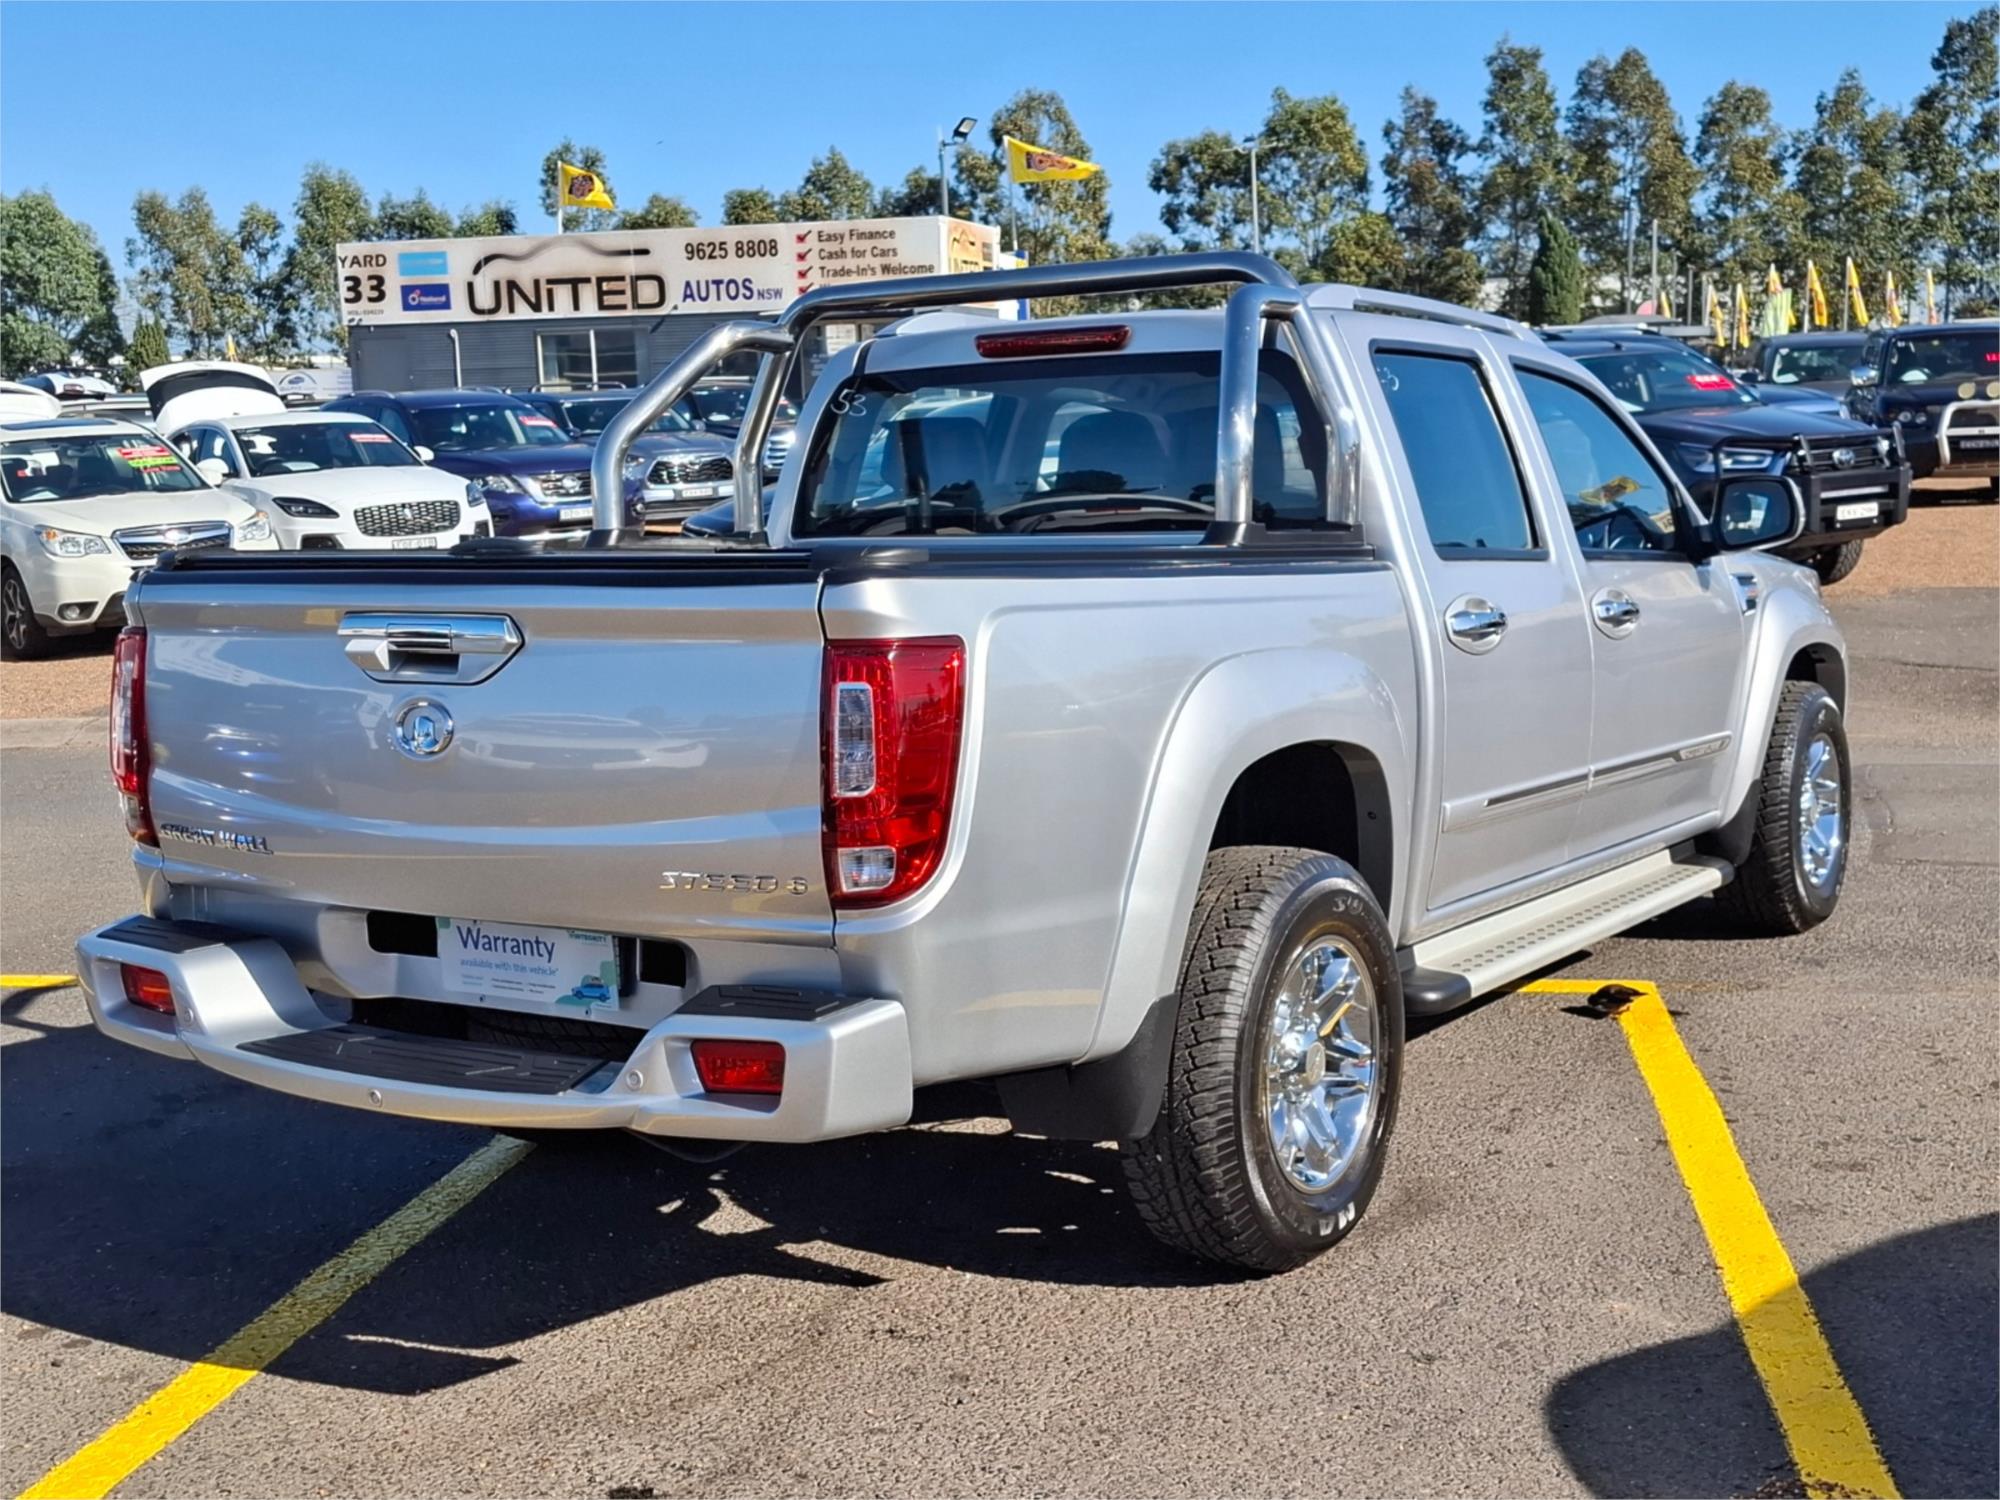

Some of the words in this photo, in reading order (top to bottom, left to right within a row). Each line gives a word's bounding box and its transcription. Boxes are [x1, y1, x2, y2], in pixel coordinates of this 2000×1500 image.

[817, 230, 845, 244] Easy
[849, 229, 896, 241] Finance
[338, 254, 387, 268] YARD
[684, 241, 728, 261] 9625
[735, 238, 779, 259] 8808
[818, 248, 847, 260] Cash
[851, 247, 866, 258] for
[871, 246, 898, 258] Cars
[819, 264, 877, 278] Trade-In's
[880, 262, 935, 276] Welcome
[344, 274, 386, 304] 33
[682, 278, 754, 302] AUTOS
[757, 287, 783, 300] NSW
[830, 388, 867, 416] 53
[219, 830, 274, 855] WALL
[659, 871, 778, 894] STEED
[457, 925, 555, 963] Warranty
